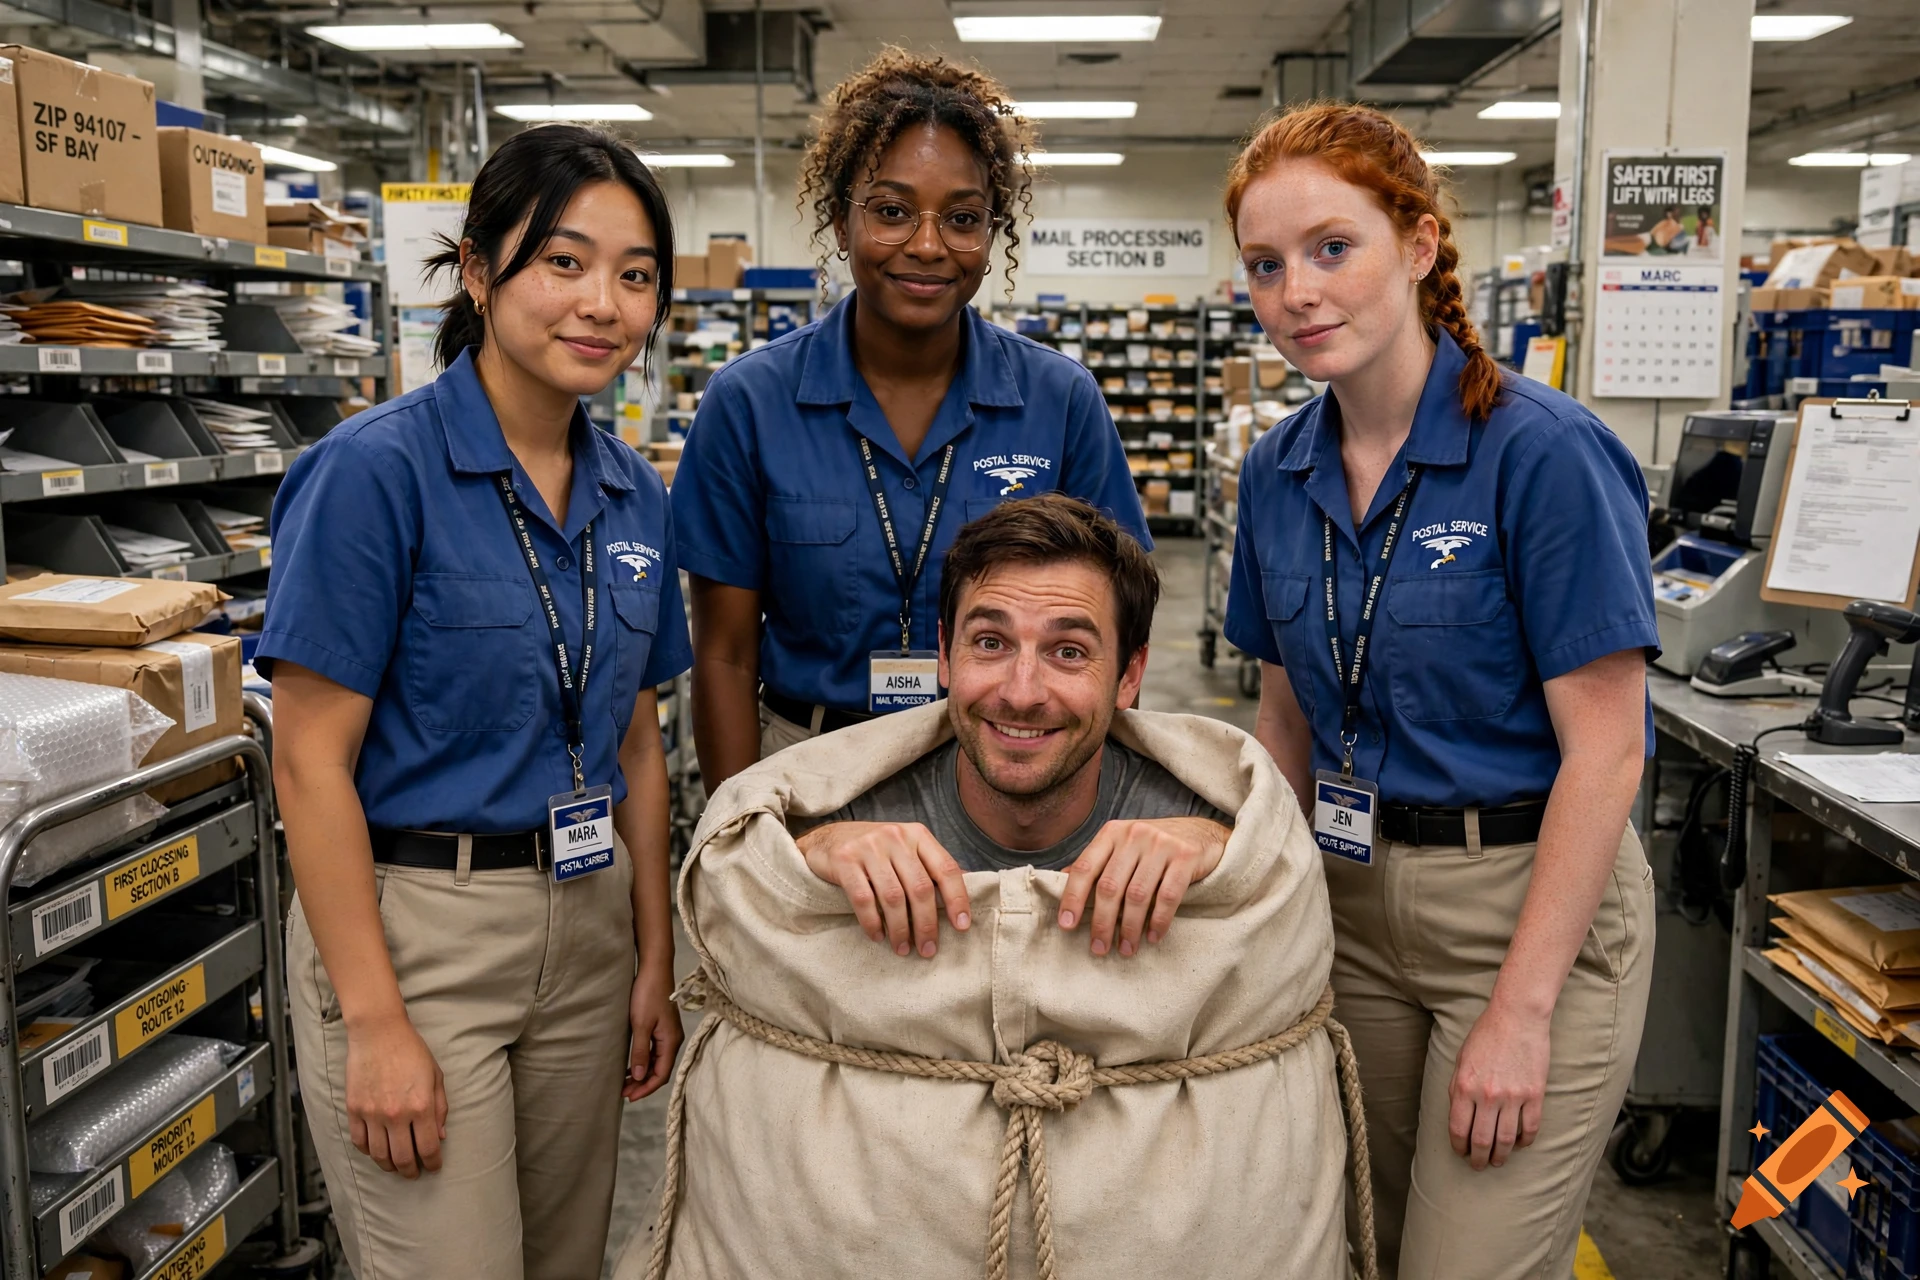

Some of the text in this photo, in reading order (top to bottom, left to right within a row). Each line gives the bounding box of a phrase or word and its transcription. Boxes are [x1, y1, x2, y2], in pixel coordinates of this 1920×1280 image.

[33, 101, 67, 128] ZIP
[74, 111, 126, 142] 94107
[35, 130, 99, 161] SF BAY
[193, 144, 256, 175] OUTGOING
[1613, 165, 1717, 186] SAFETY FIRST
[1613, 187, 1715, 205] LIFT WITH LEGS
[1031, 230, 1203, 247] MAIL PROCESSING
[1066, 251, 1165, 268] SECTION B
[1641, 270, 1682, 282] MARC
[973, 454, 1051, 471] POSTAL SERVICE
[1412, 520, 1488, 541] POSTAL SERVICE
[606, 541, 661, 561] POSTAL SERVICE
[885, 676, 921, 688] AISHA
[875, 696, 892, 704] MAIL
[1332, 809, 1352, 827] JEN
[568, 824, 598, 844] MARA
[1318, 835, 1367, 856] ROUTE SUPPORT
[560, 860, 584, 874] POSTAL
[113, 867, 138, 892] FIRST
[130, 867, 180, 903] SECTION B
[141, 999, 185, 1036] ROUTE 12
[151, 1114, 193, 1158] PRIORITY
[186, 1131, 195, 1148] 12
